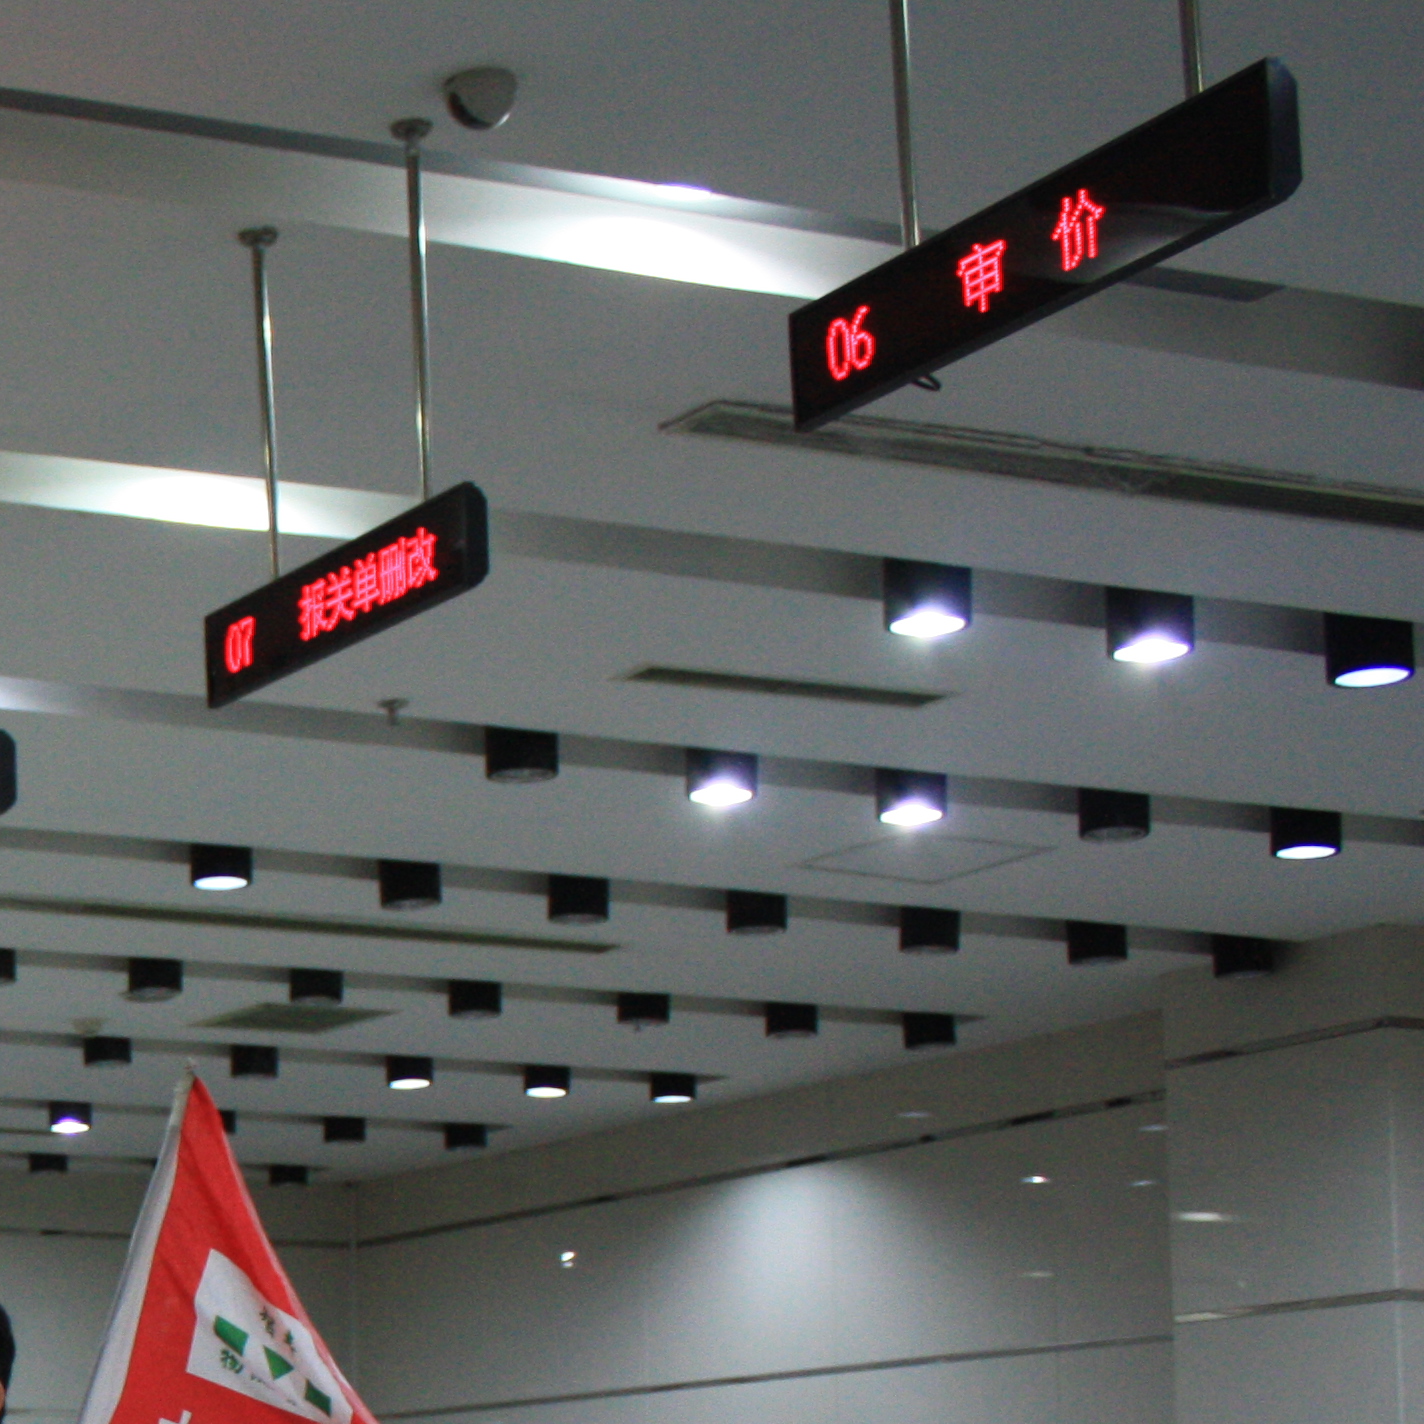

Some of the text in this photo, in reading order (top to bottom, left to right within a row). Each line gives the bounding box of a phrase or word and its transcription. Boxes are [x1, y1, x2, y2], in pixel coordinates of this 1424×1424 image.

[825, 304, 876, 381] 06
[224, 526, 440, 674] 07 报关单删改
